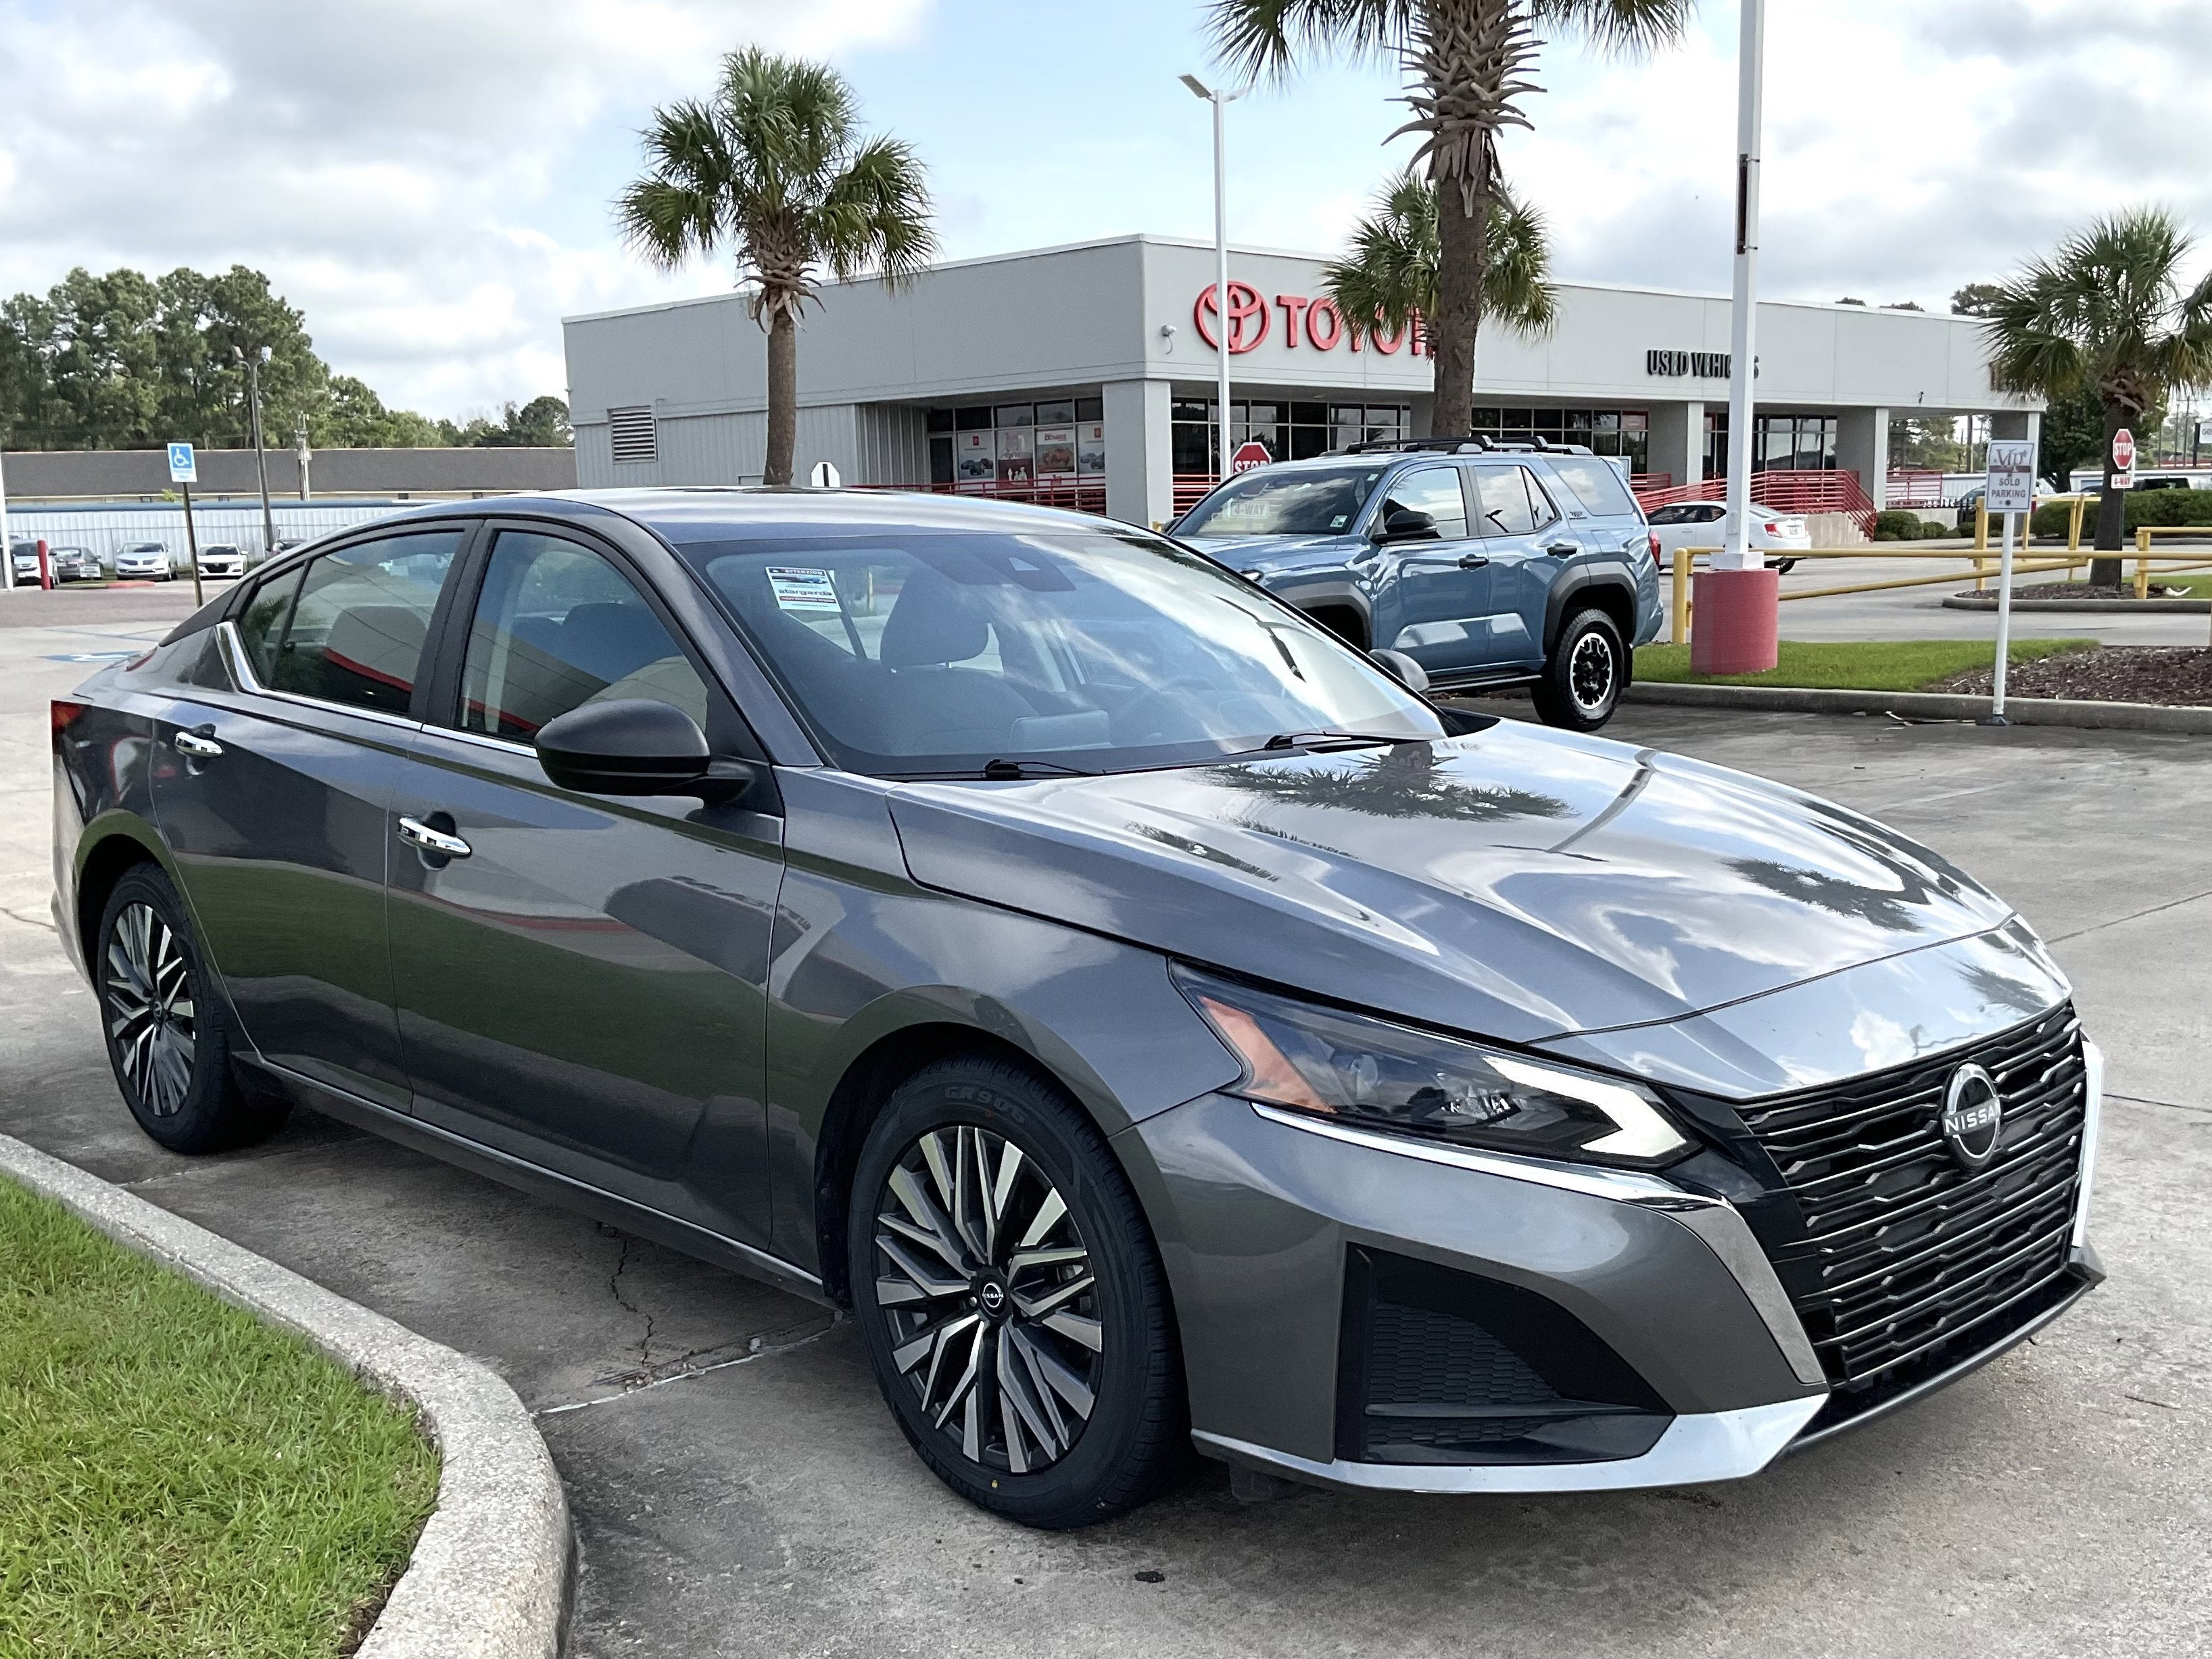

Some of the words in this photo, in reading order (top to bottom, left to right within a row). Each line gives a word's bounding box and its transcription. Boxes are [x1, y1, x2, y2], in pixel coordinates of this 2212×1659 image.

[1647, 350, 1689, 376] USED
[2115, 442, 2132, 456] STOP
[1999, 478, 2020, 486] SOLD
[2114, 477, 2131, 485] 4-WAY
[1992, 489, 2026, 498] PARKING
[1234, 503, 1265, 515] 4-WAY
[1944, 1100, 2001, 1133] NISSAN
